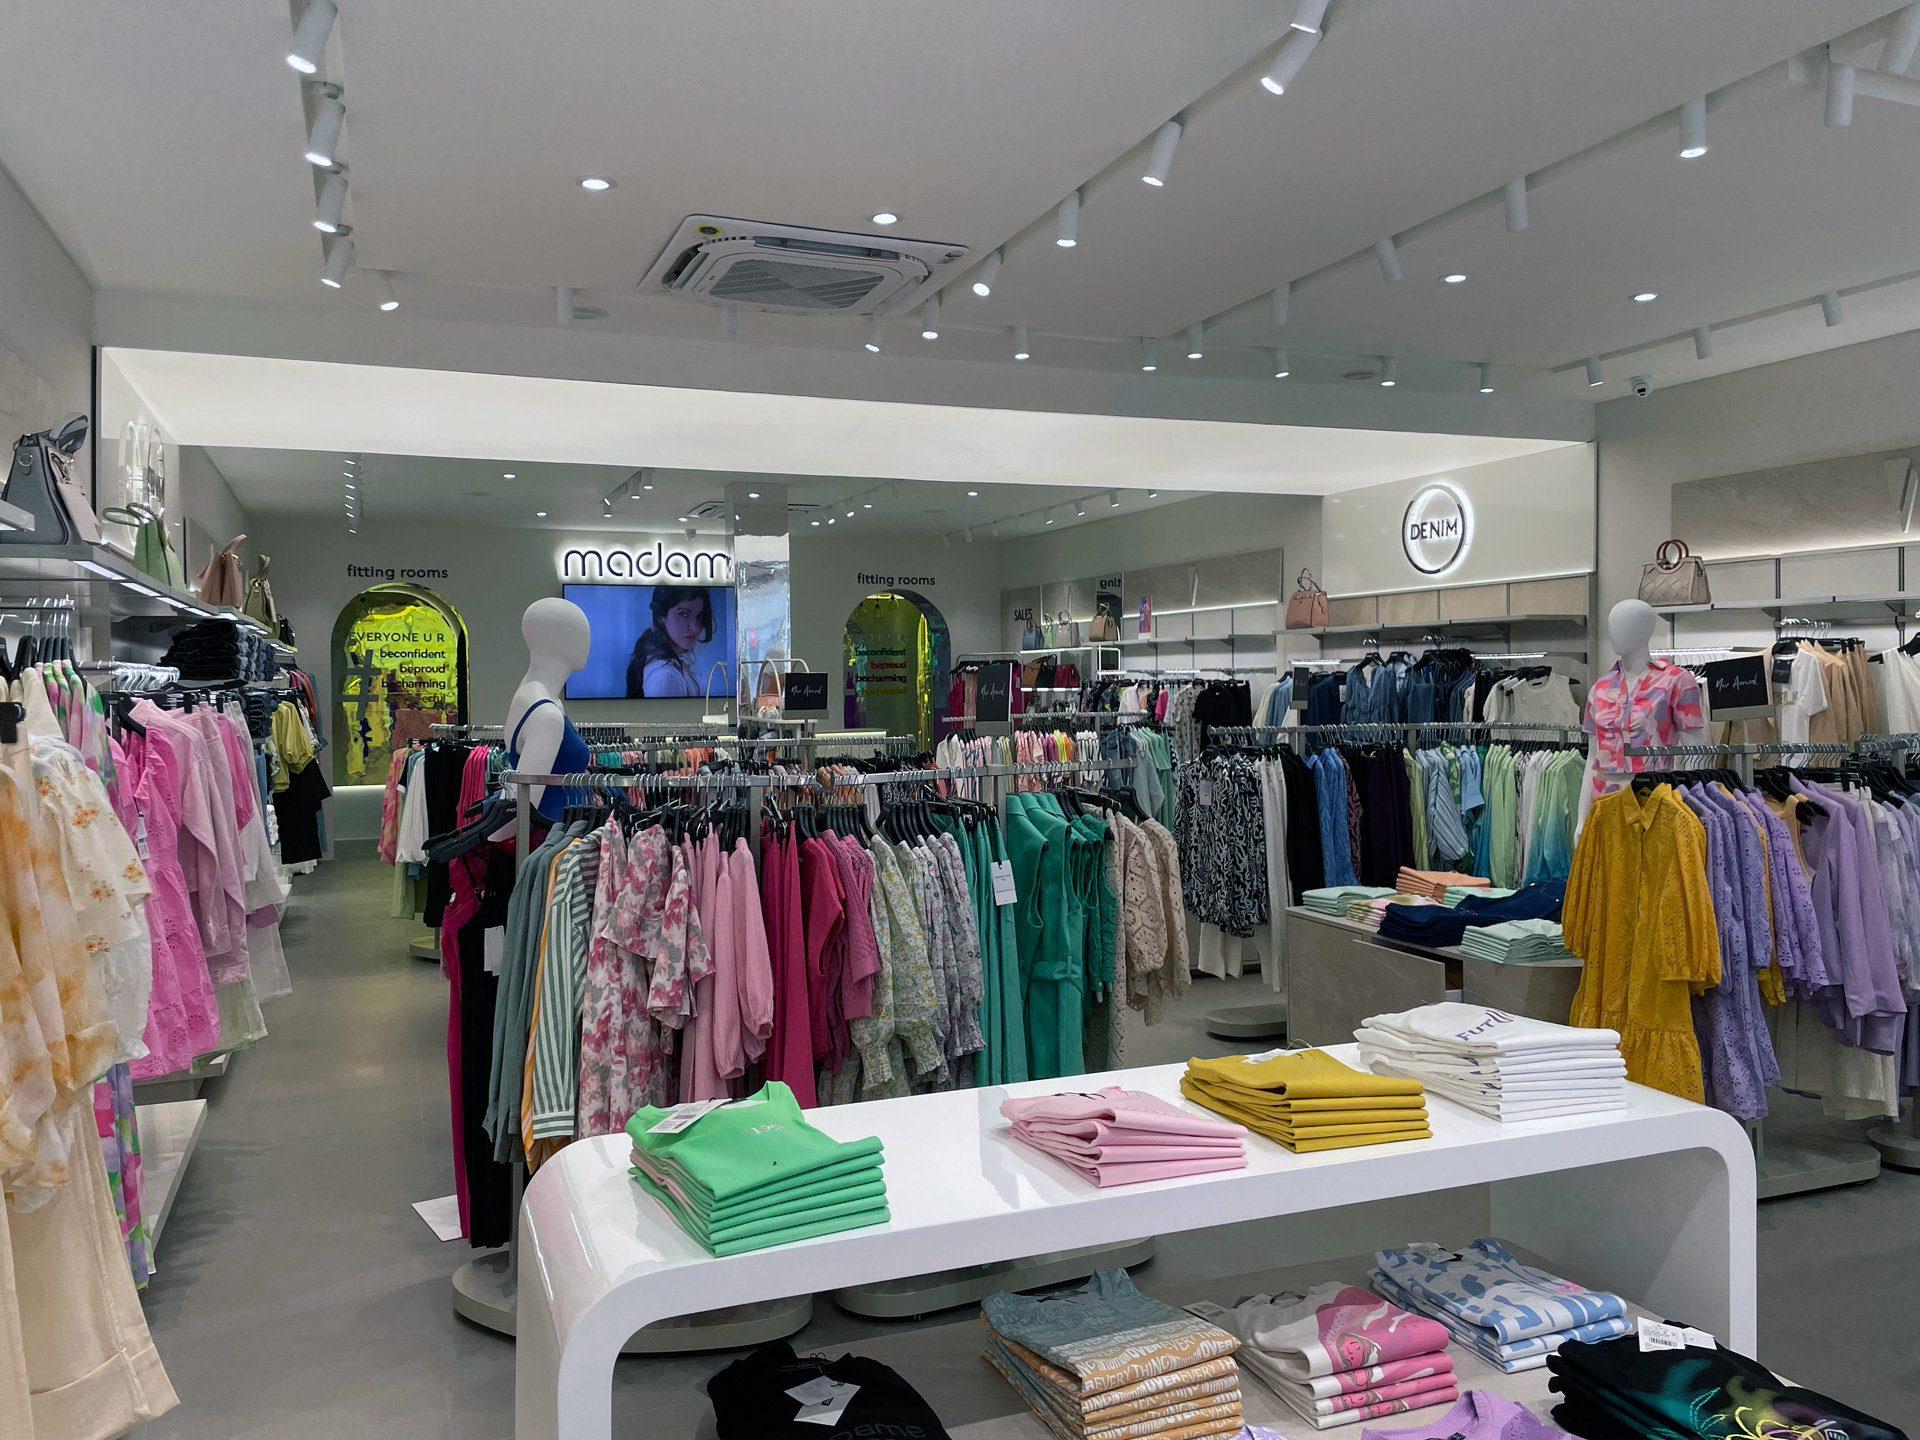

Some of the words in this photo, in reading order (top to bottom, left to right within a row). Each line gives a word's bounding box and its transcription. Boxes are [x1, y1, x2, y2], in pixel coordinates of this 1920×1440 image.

[1410, 517, 1458, 540] DENIM
[347, 564, 395, 580] fitting
[400, 568, 449, 578] rooms
[857, 573, 894, 587] fitting
[898, 577, 936, 586] rooms
[1013, 608, 1033, 621] SALES
[350, 632, 419, 643] EVERYONE
[423, 632, 432, 643] U
[437, 633, 446, 643] R
[379, 648, 446, 659] beconfident
[399, 664, 446, 676] beproud
[381, 679, 446, 690] becharming
